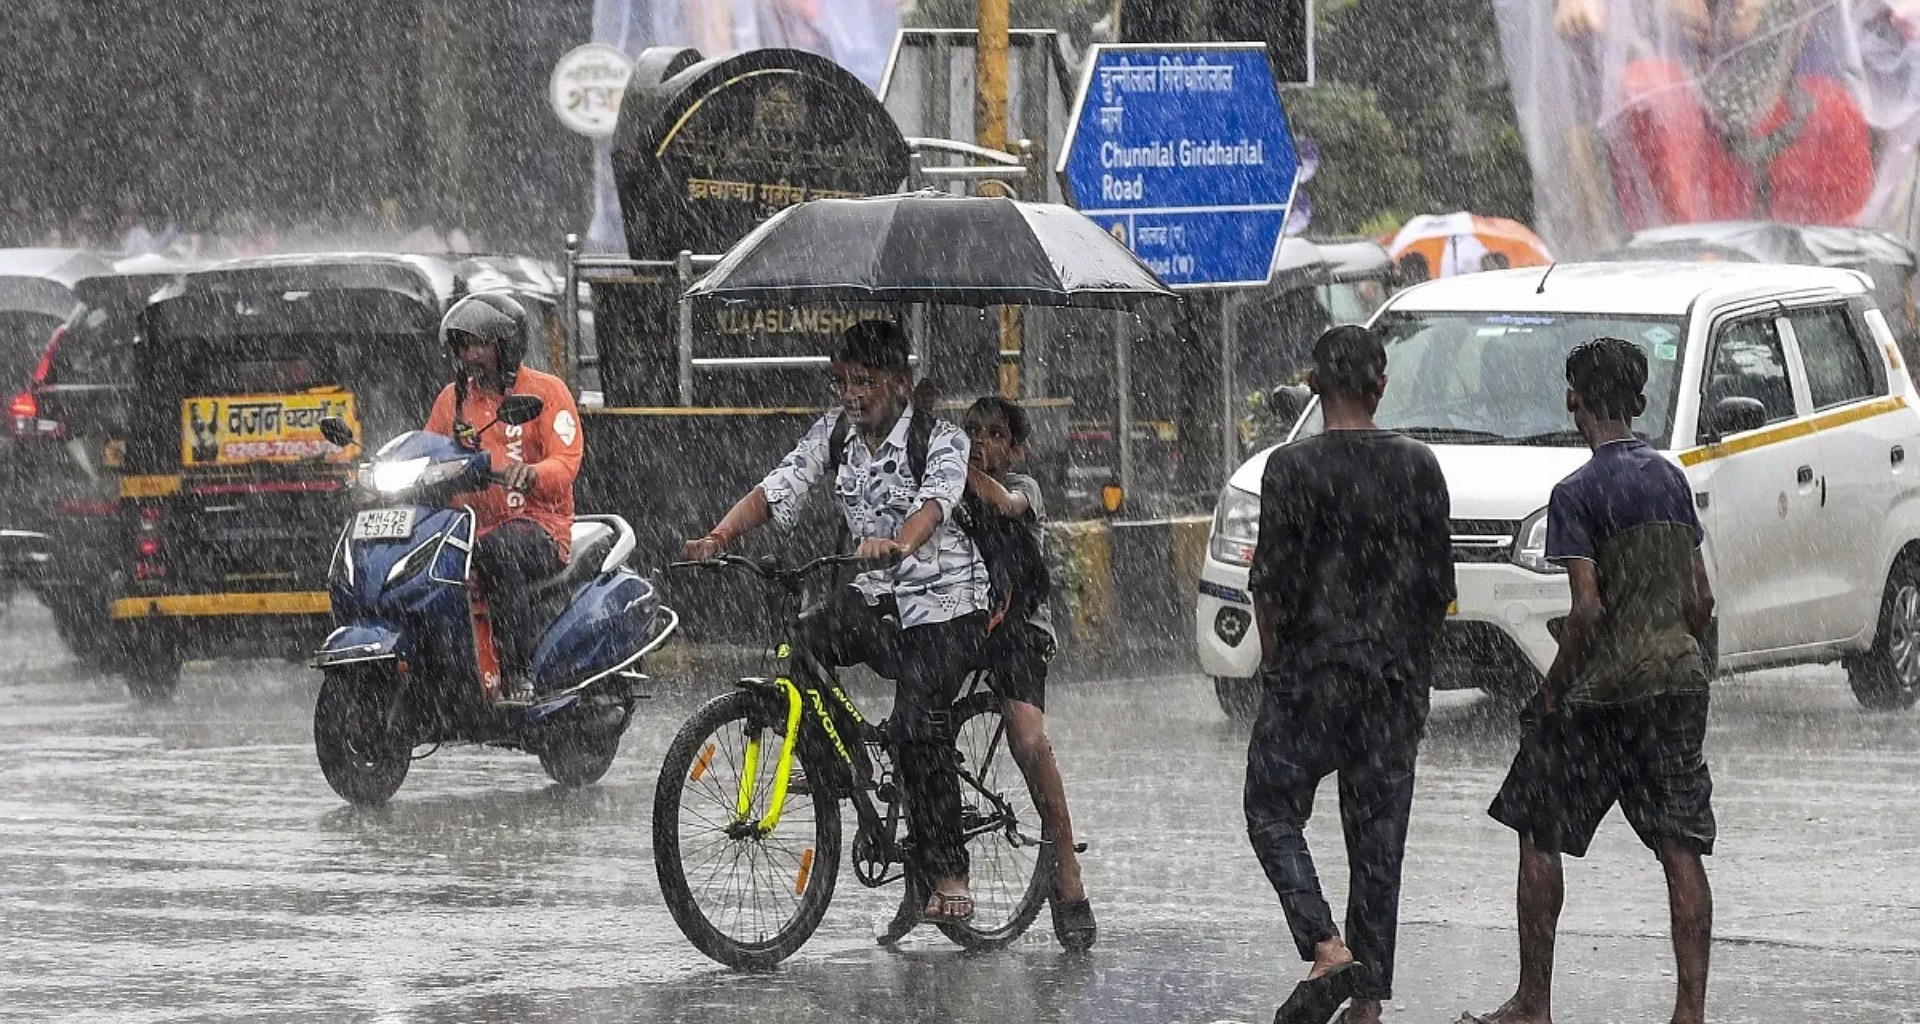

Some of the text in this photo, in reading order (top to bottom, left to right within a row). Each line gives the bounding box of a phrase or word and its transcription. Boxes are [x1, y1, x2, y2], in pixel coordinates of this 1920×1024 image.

[1101, 138, 1263, 167] Chunnilal Giridharilal
[1101, 173, 1143, 200] Road
[1143, 256, 1170, 275] alad
[228, 402, 283, 436] वजन
[505, 424, 525, 509] SWG
